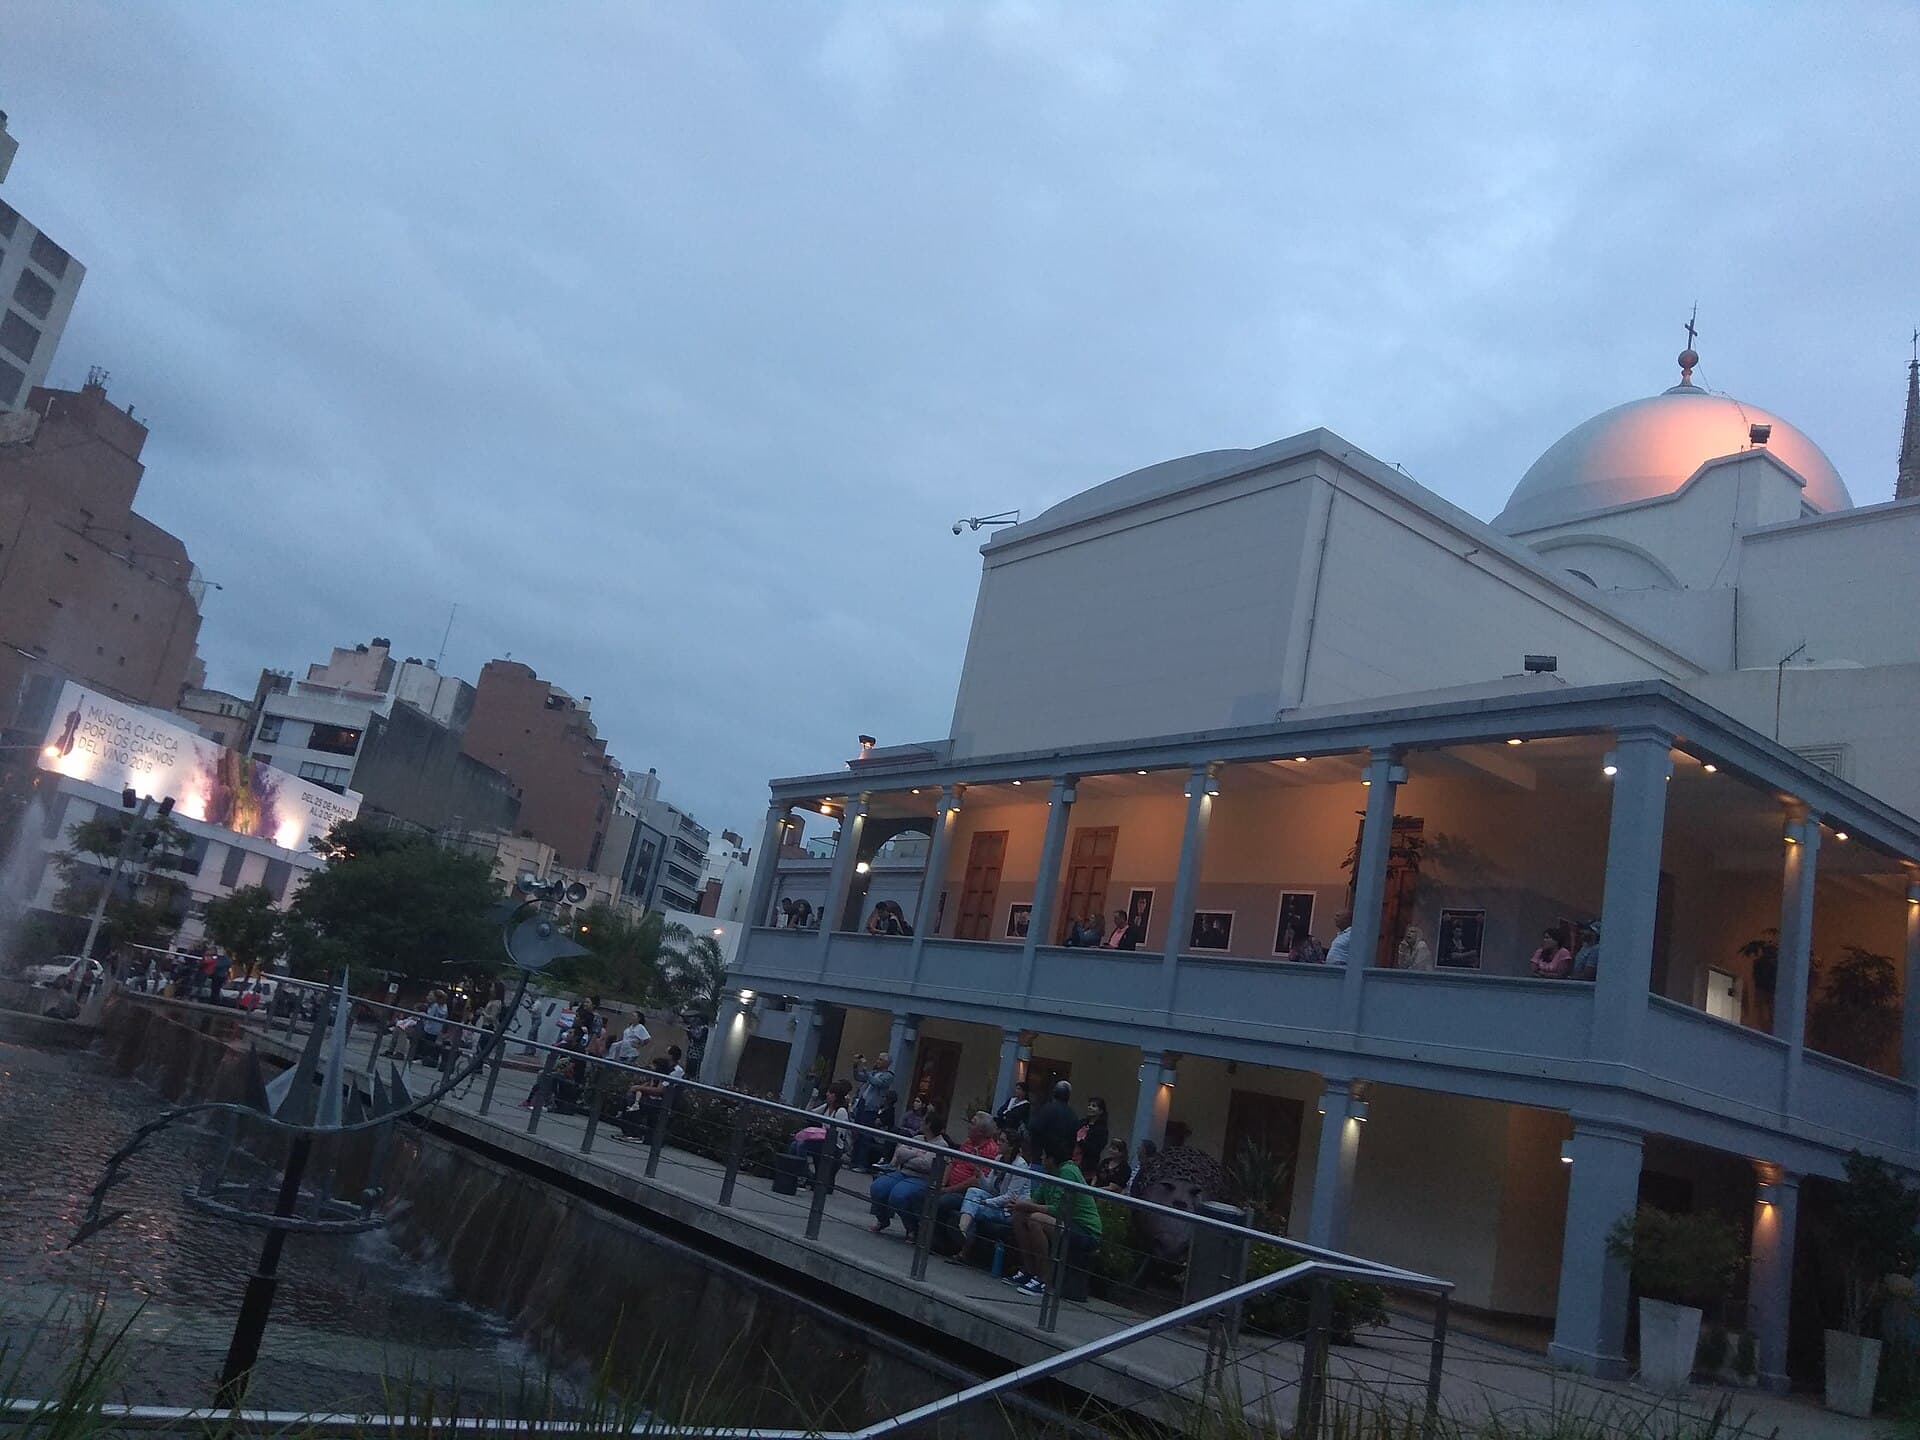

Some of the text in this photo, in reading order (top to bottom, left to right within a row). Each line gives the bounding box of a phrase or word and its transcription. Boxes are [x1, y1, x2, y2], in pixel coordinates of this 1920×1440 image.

[78, 736, 98, 756] DEL
[103, 745, 129, 765] VINO
[129, 756, 153, 774] 2018
[82, 721, 176, 767] POR LOS CAMINOS
[301, 791, 313, 804] DEL
[322, 800, 332, 811] DE
[332, 803, 353, 818] MARZO
[309, 806, 317, 817] AL
[323, 811, 333, 822] DE
